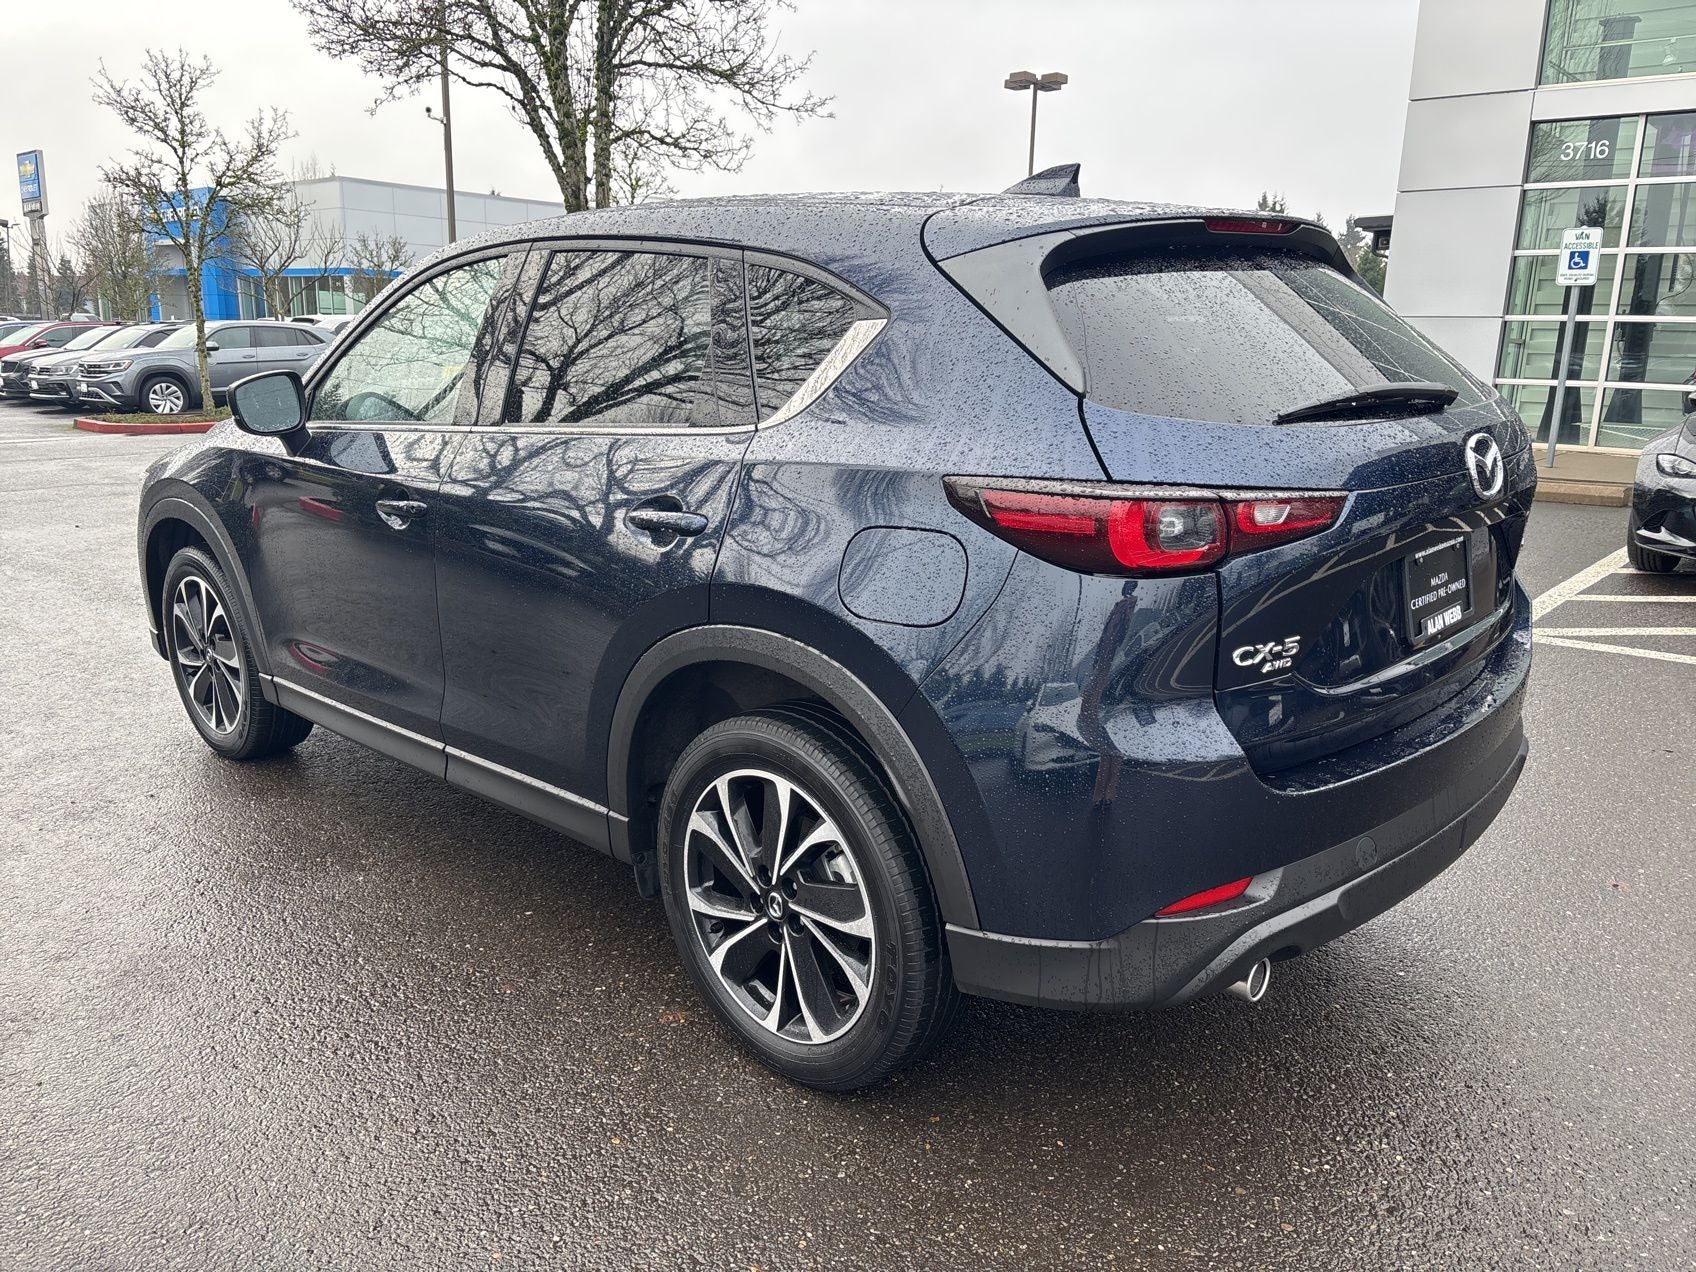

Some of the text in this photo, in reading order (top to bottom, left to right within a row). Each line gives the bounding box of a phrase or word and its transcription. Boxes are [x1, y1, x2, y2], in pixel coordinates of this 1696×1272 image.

[1560, 140, 1610, 161] 3716
[1575, 232, 1590, 240] VAN
[1564, 242, 1599, 250] ACCESSIBLE
[1430, 572, 1449, 587] MAZDA
[1410, 578, 1466, 610] CERTIFIED PRE-OWNED
[1427, 605, 1462, 635] ALAN WEBB
[1232, 635, 1301, 667] CX-5
[1260, 657, 1293, 673] AWD
